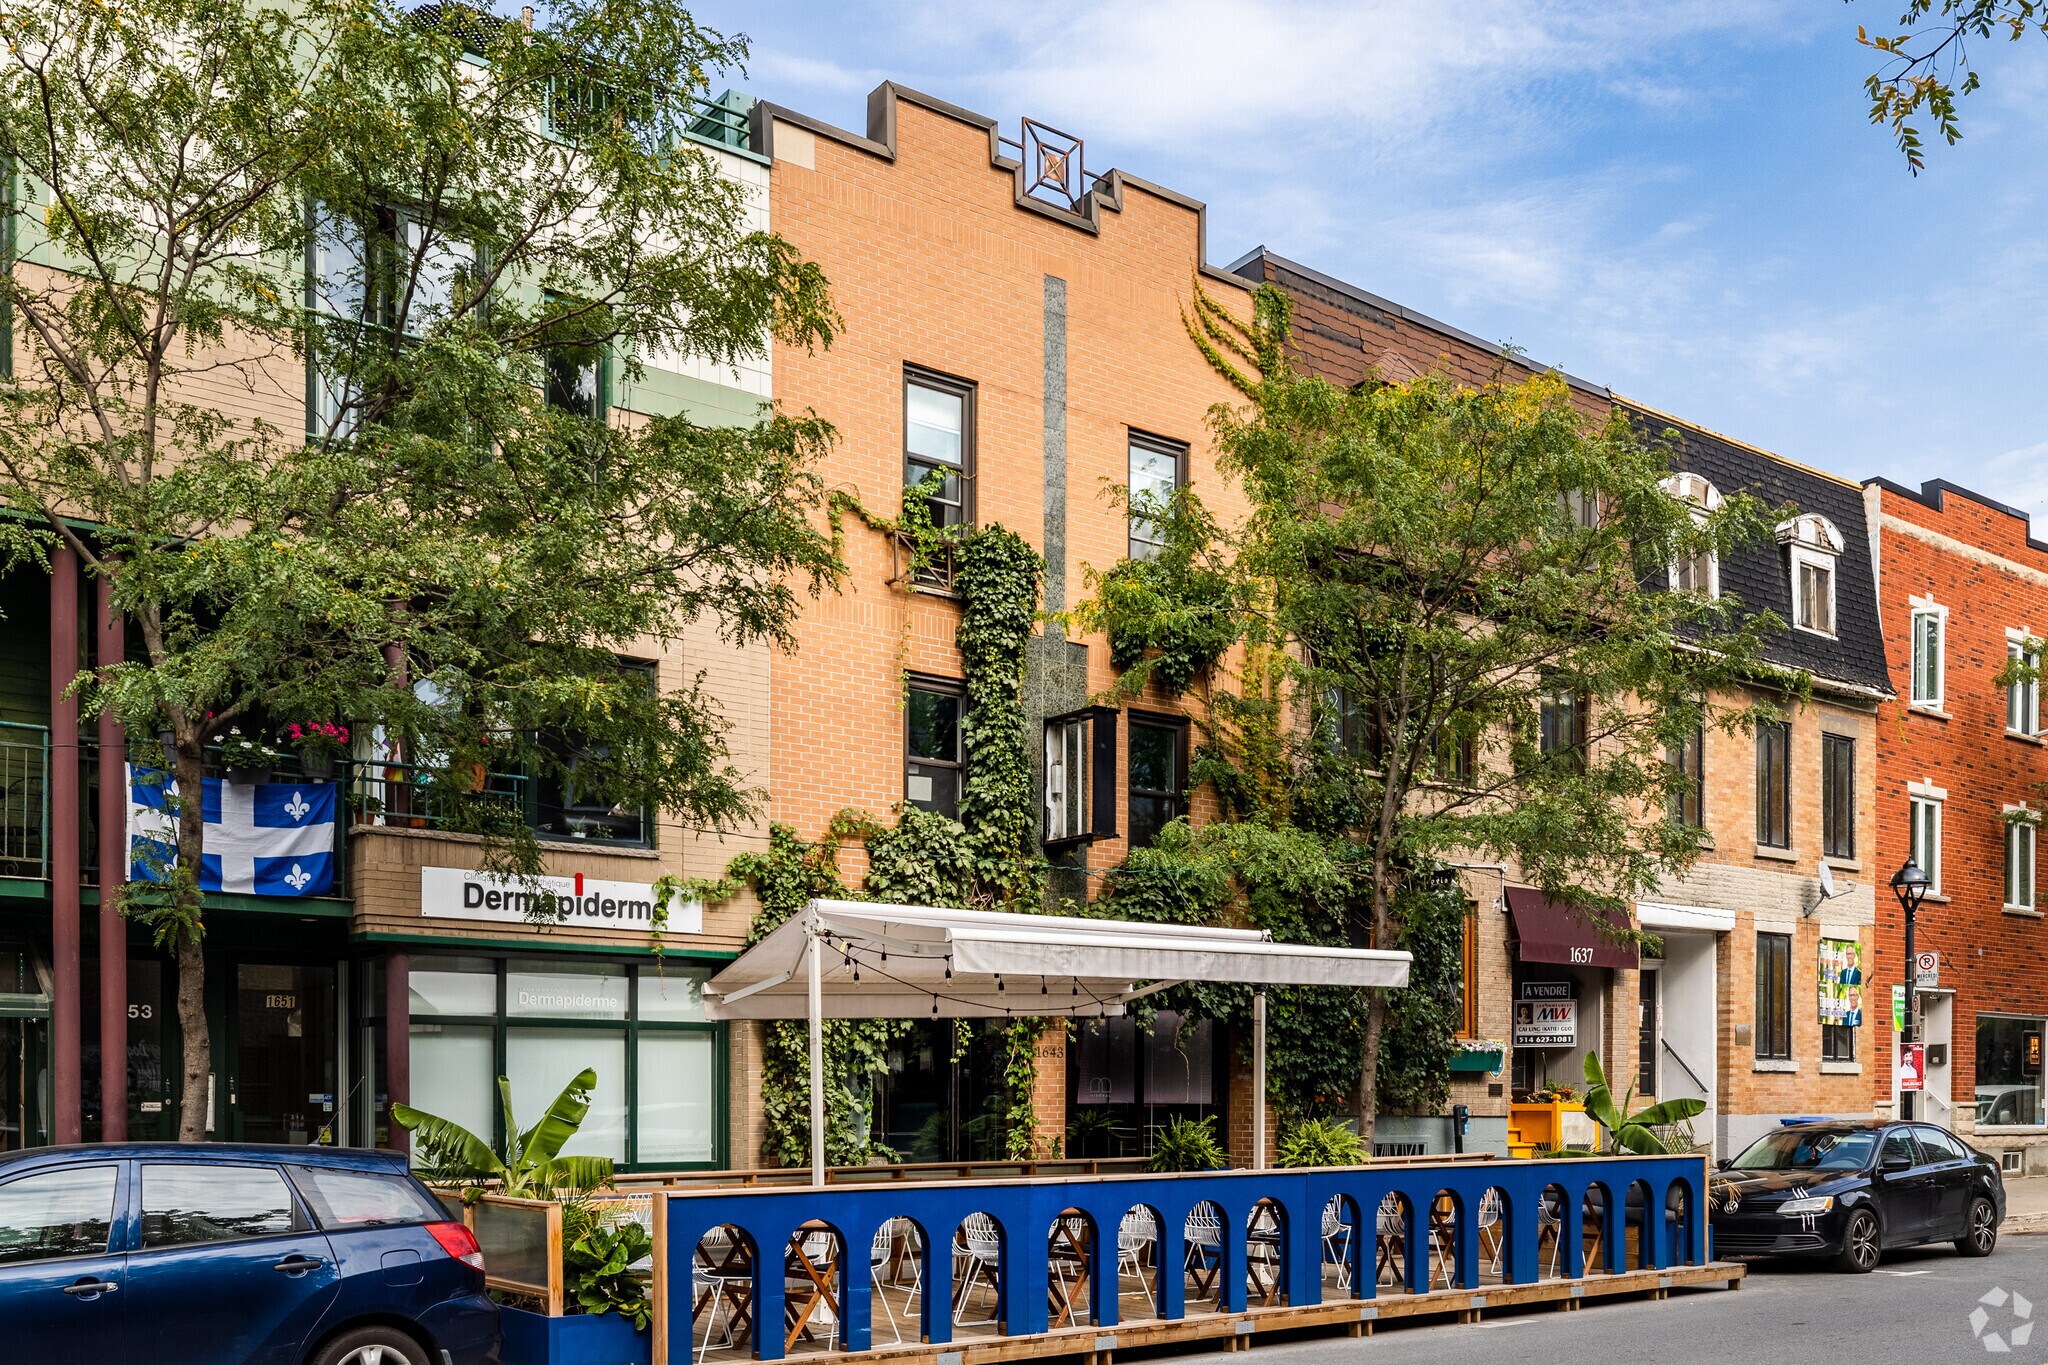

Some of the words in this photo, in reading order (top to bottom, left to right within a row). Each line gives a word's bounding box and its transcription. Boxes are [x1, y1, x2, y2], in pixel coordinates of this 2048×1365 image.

[464, 871, 496, 884] Cliniqu
[464, 882, 668, 922] Dermpiderm
[1570, 946, 1593, 963] 1637
[1534, 986, 1567, 996] VENDRE
[266, 995, 296, 1008] 1651
[518, 991, 618, 1009] Dermapiderme
[1536, 1007, 1571, 1021] MW
[1035, 1046, 1064, 1058] 1643
